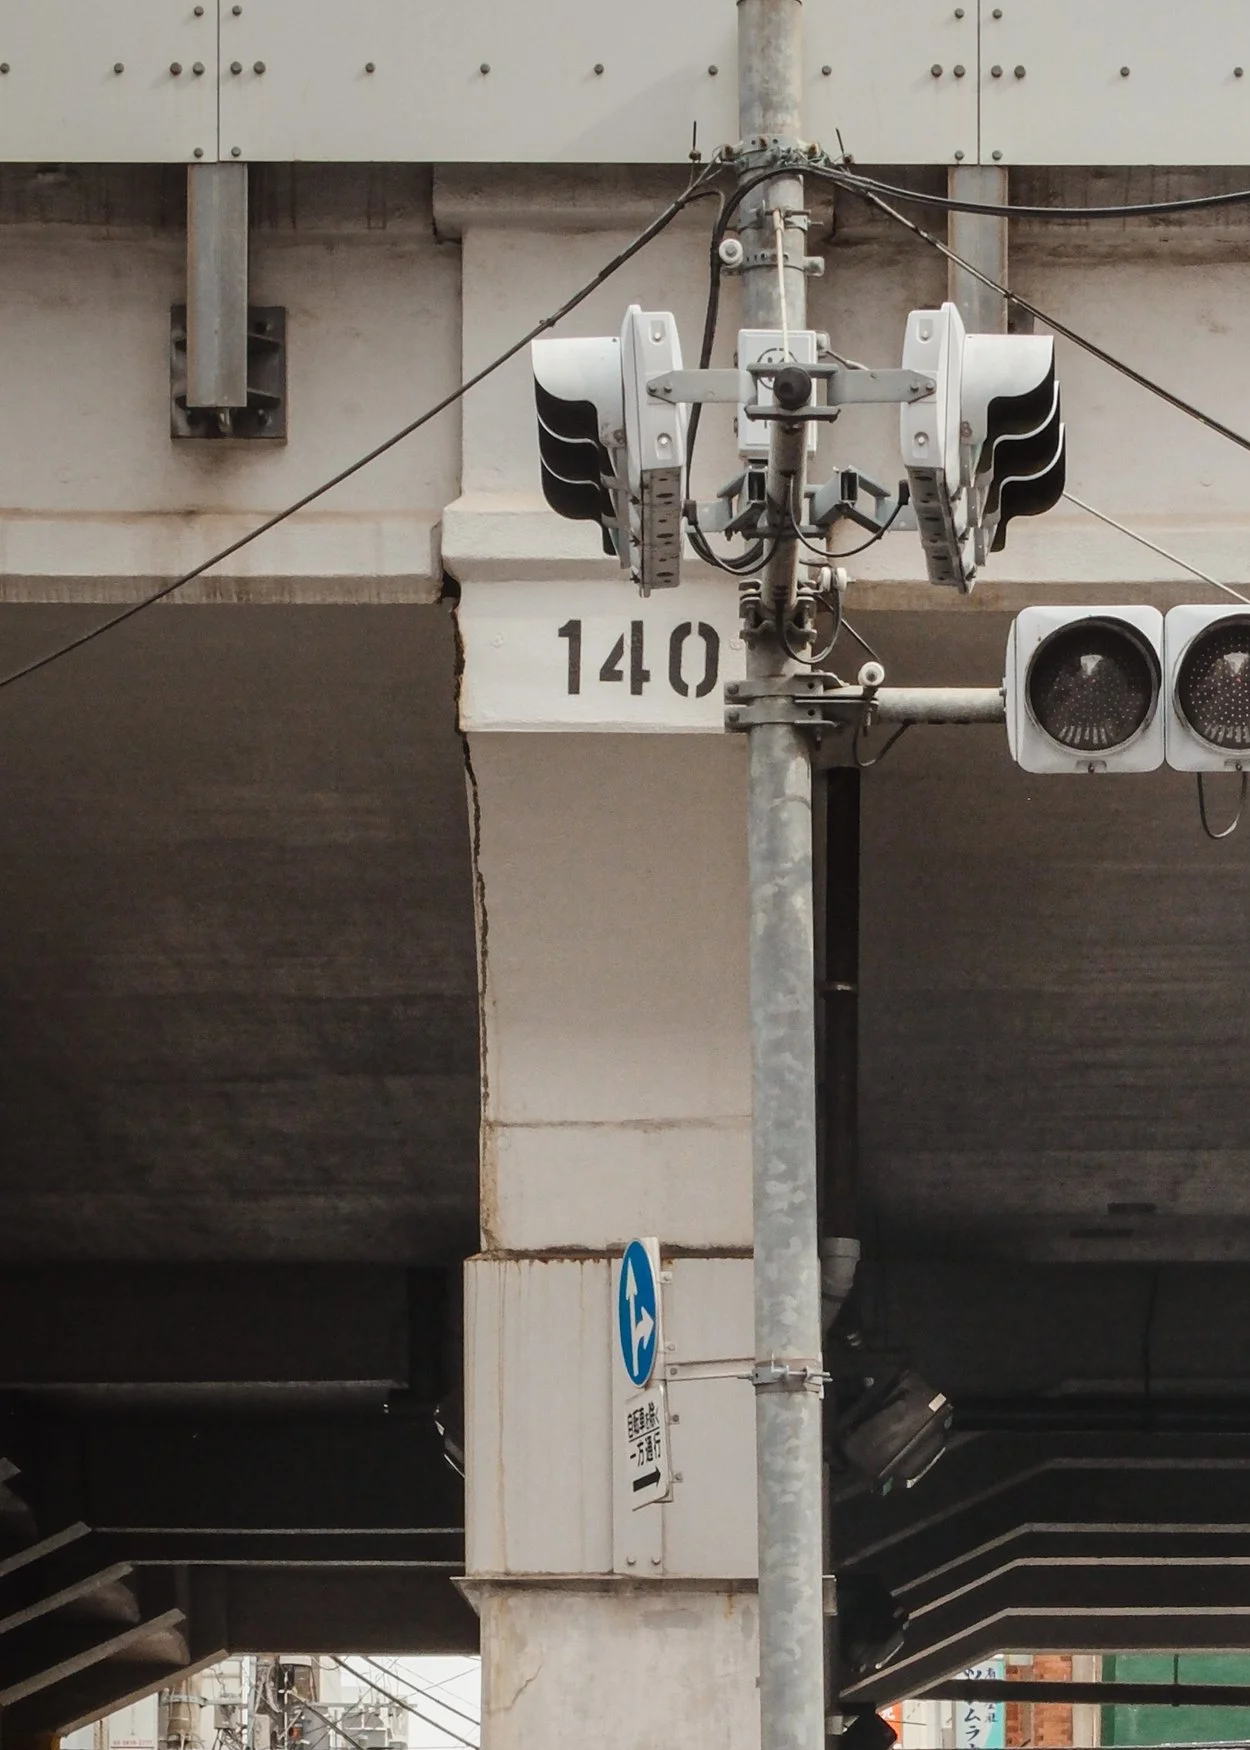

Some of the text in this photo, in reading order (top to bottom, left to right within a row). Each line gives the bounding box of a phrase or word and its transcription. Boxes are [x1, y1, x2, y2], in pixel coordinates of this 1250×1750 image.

[558, 619, 720, 698] 140
[629, 1431, 661, 1467] 一方通行
